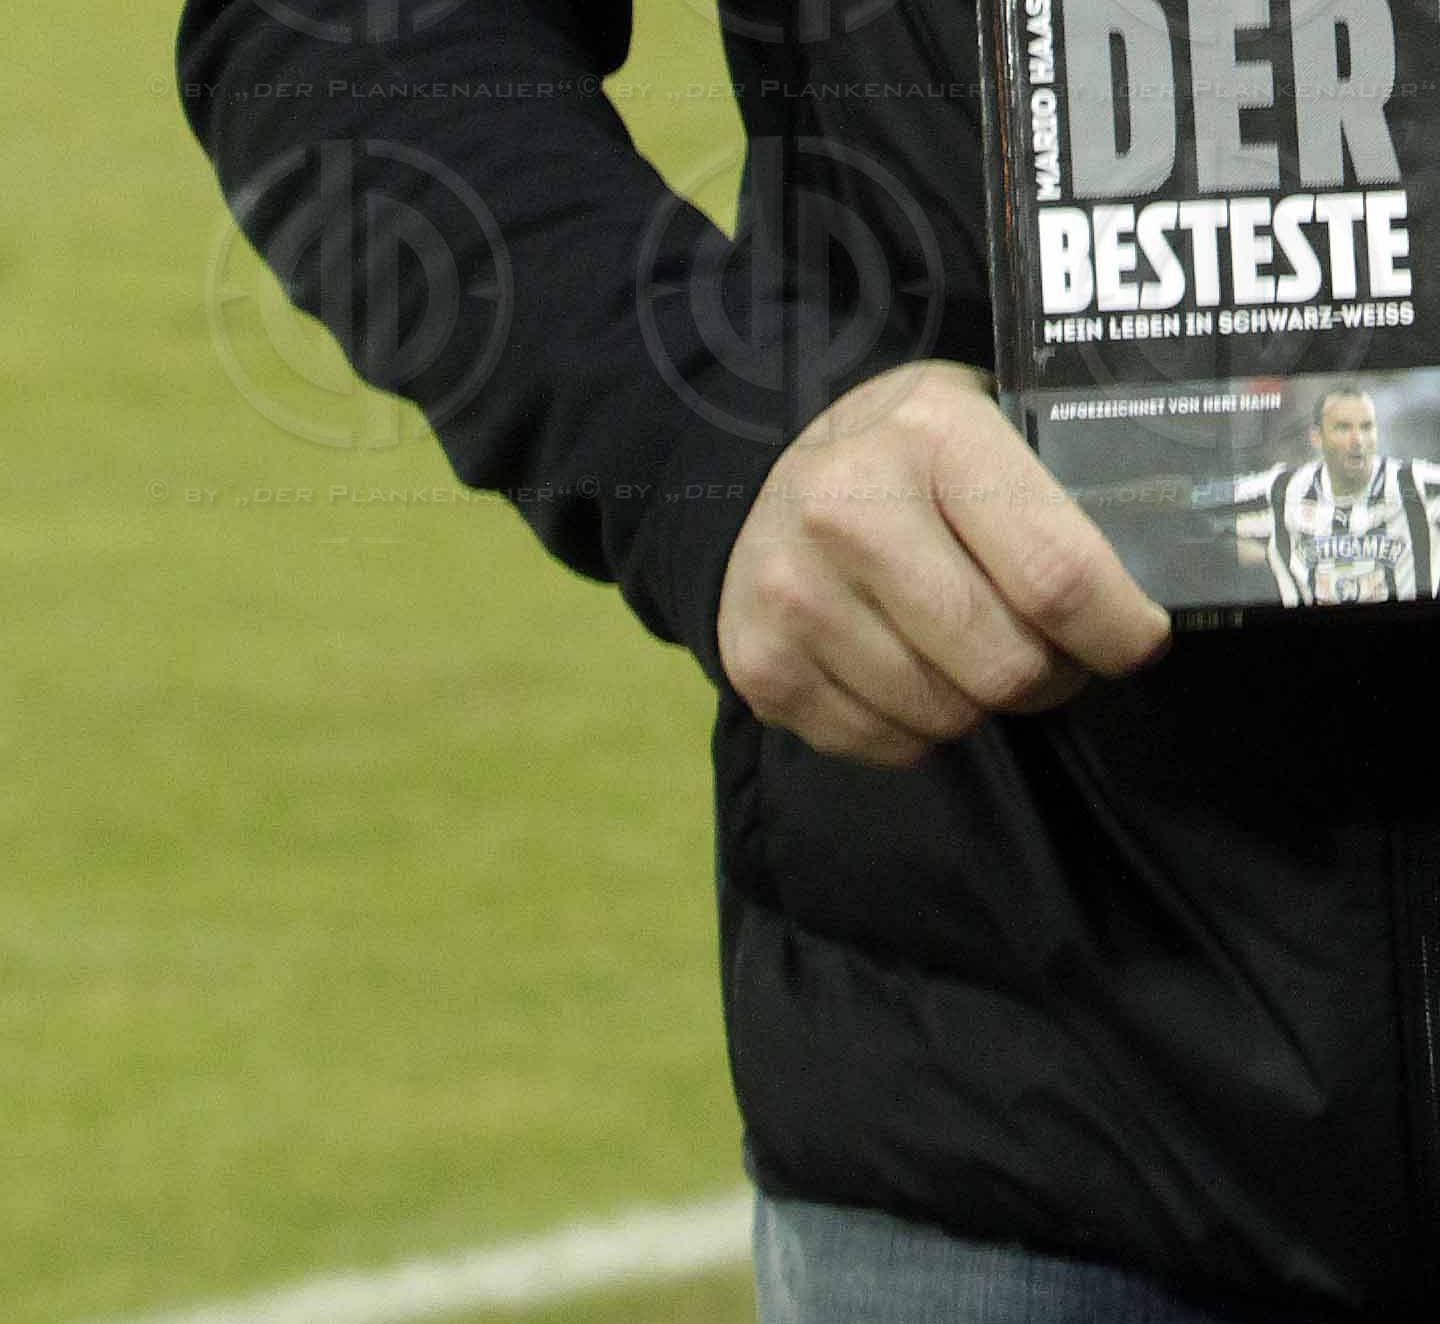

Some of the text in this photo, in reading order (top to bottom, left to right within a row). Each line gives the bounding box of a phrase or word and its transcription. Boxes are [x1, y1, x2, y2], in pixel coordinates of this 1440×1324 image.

[1031, 88, 1061, 201] MARIO
[1038, 190, 1412, 314] BESTESTE
[1044, 302, 1414, 343] MEIN LEBEN IN SCHWARZ-WEISS
[1168, 397, 1200, 415] VON
